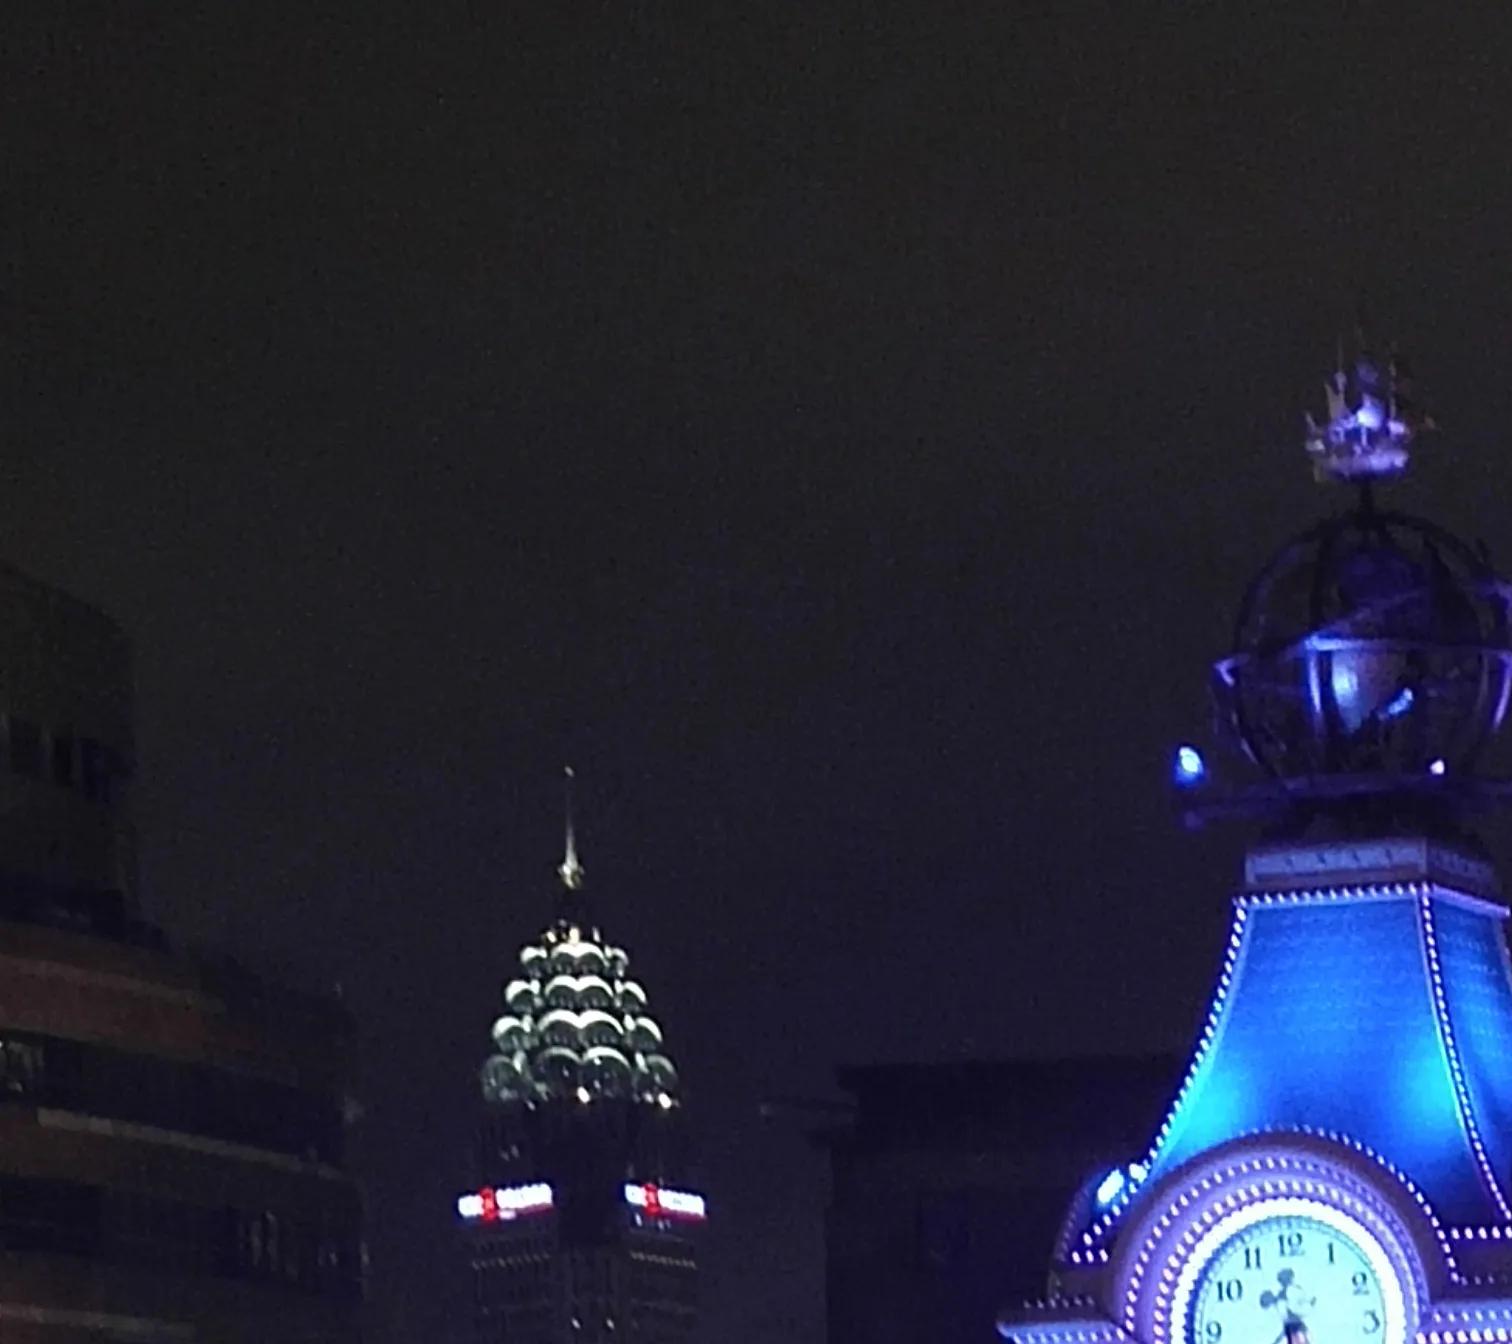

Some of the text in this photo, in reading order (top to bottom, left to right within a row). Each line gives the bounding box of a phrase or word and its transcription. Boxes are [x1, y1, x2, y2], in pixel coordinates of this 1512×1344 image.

[1278, 1233, 1304, 1256] 12
[1328, 1243, 1335, 1264] 1
[1245, 1247, 1261, 1270] 11
[1217, 1279, 1242, 1302] 10
[1352, 1272, 1369, 1295] 2
[1207, 1321, 1221, 1344] 9
[1363, 1310, 1379, 1334] 3
